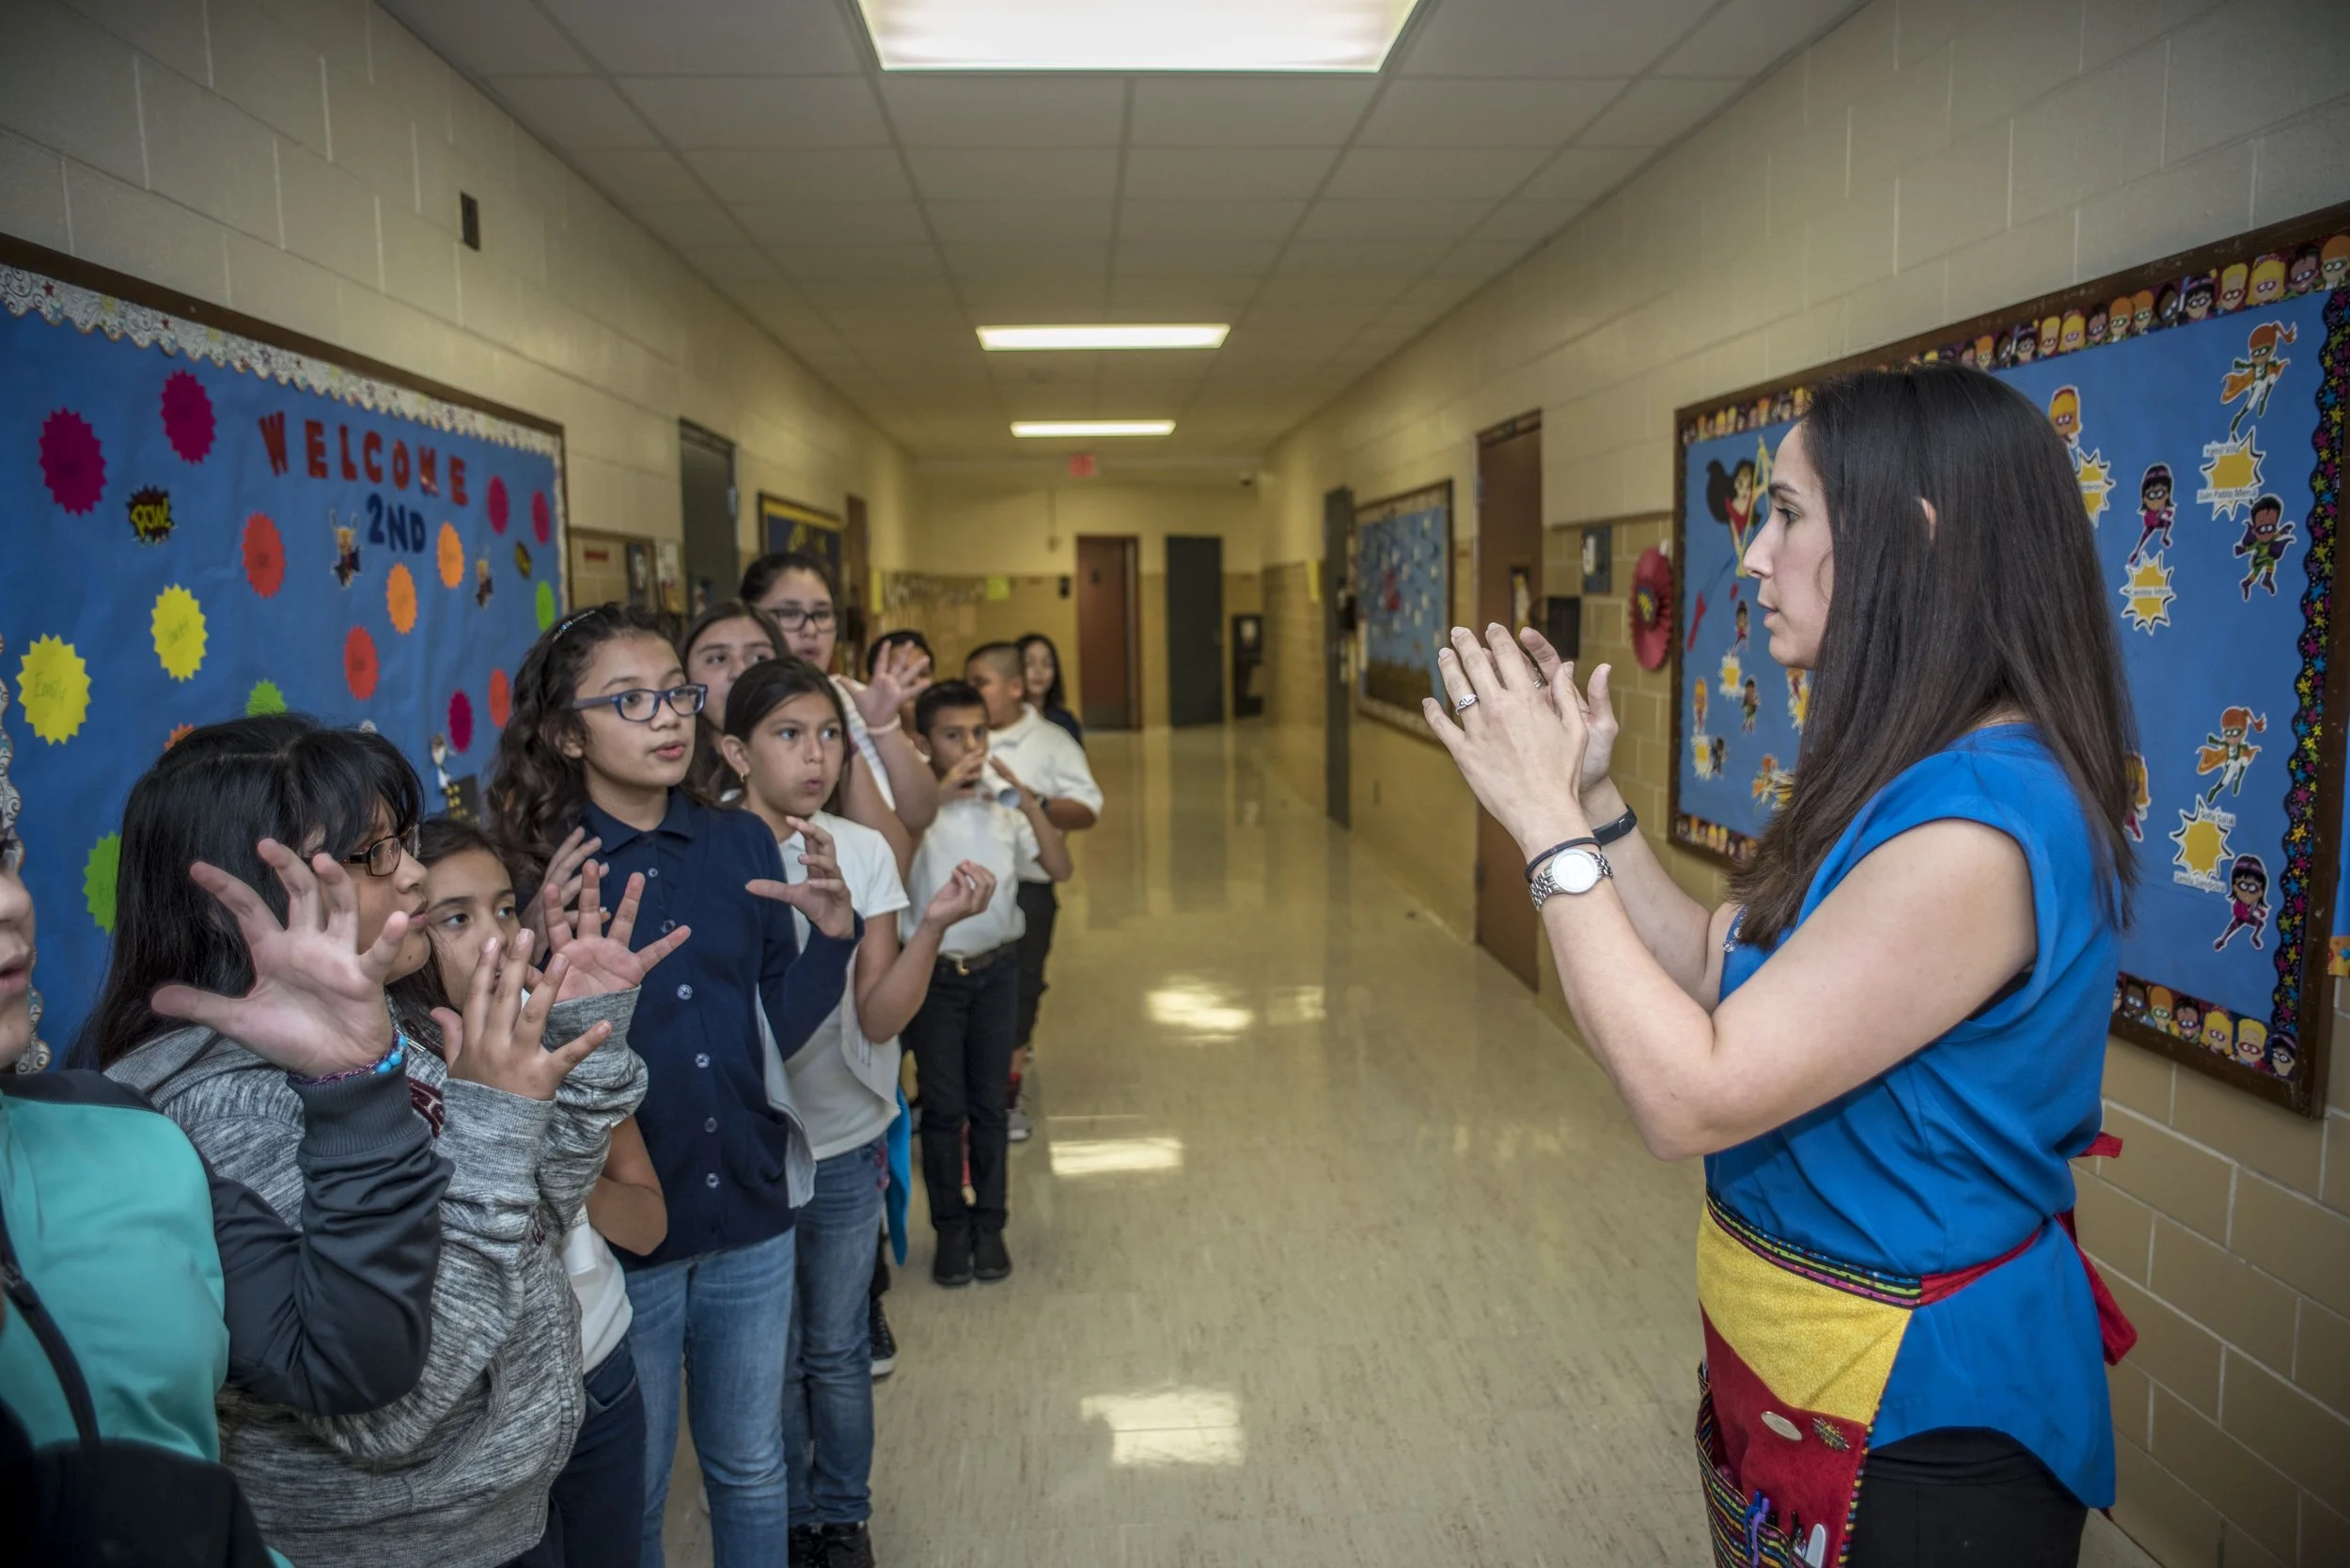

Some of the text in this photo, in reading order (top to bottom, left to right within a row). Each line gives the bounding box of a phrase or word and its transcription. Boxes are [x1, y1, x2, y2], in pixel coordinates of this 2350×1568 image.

[258, 411, 469, 508] WELCOME
[367, 492, 426, 554] 2ND
[34, 672, 69, 710] Emily
